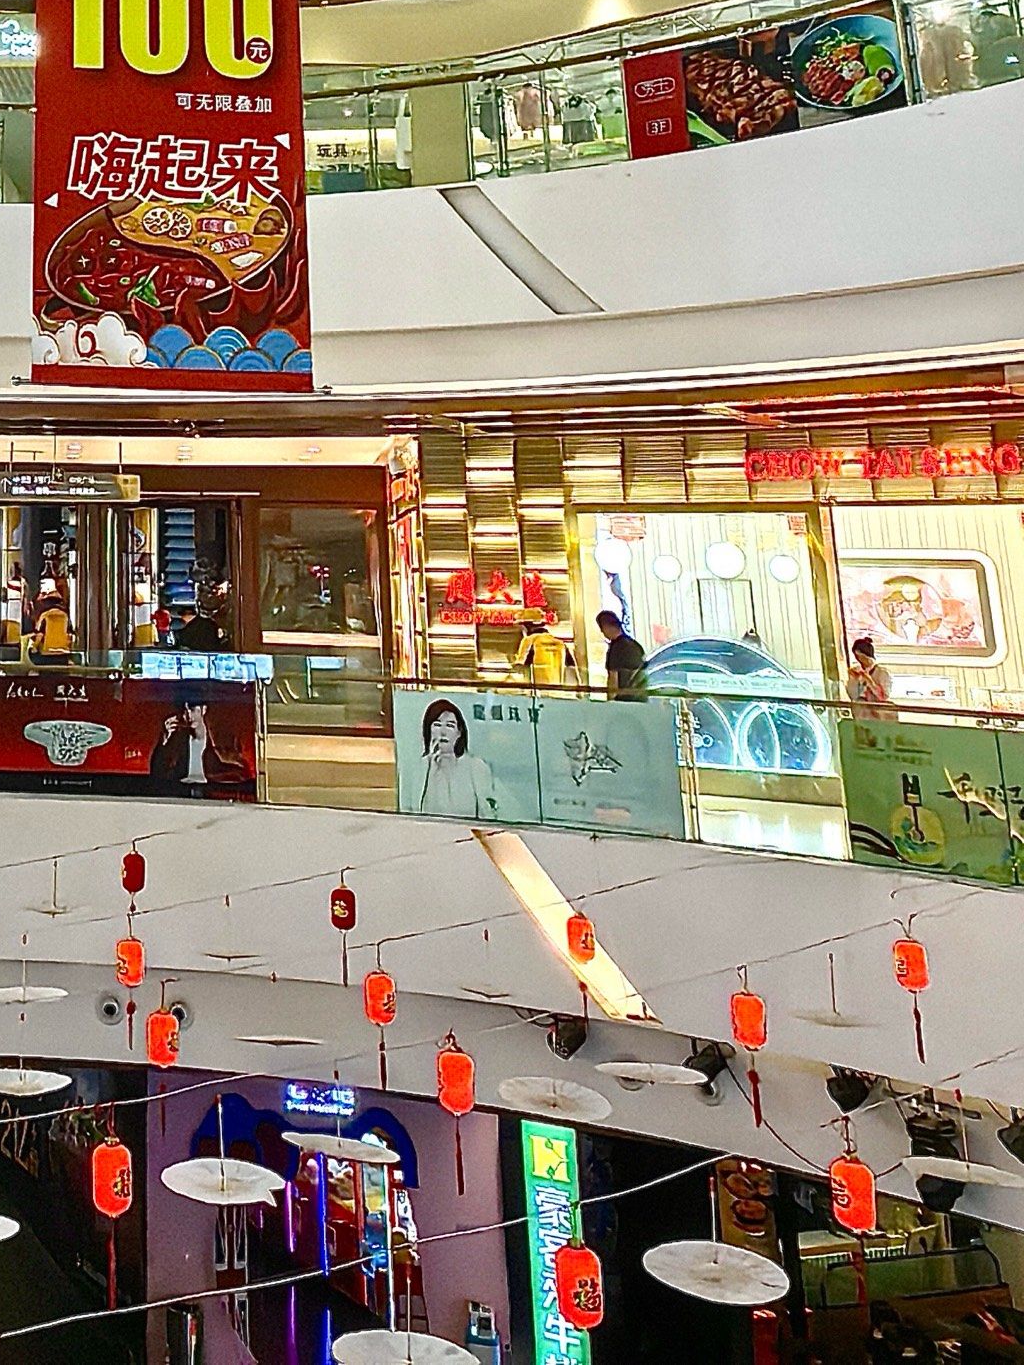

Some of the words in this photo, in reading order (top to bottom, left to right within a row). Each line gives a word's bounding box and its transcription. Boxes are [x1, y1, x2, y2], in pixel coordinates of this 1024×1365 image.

[249, 41, 268, 60] 元
[175, 92, 272, 113] 可无限叠加
[316, 142, 349, 158] 玩具
[67, 131, 281, 205] 嗨起来
[744, 447, 844, 482] CHOW
[858, 446, 915, 479] TAI
